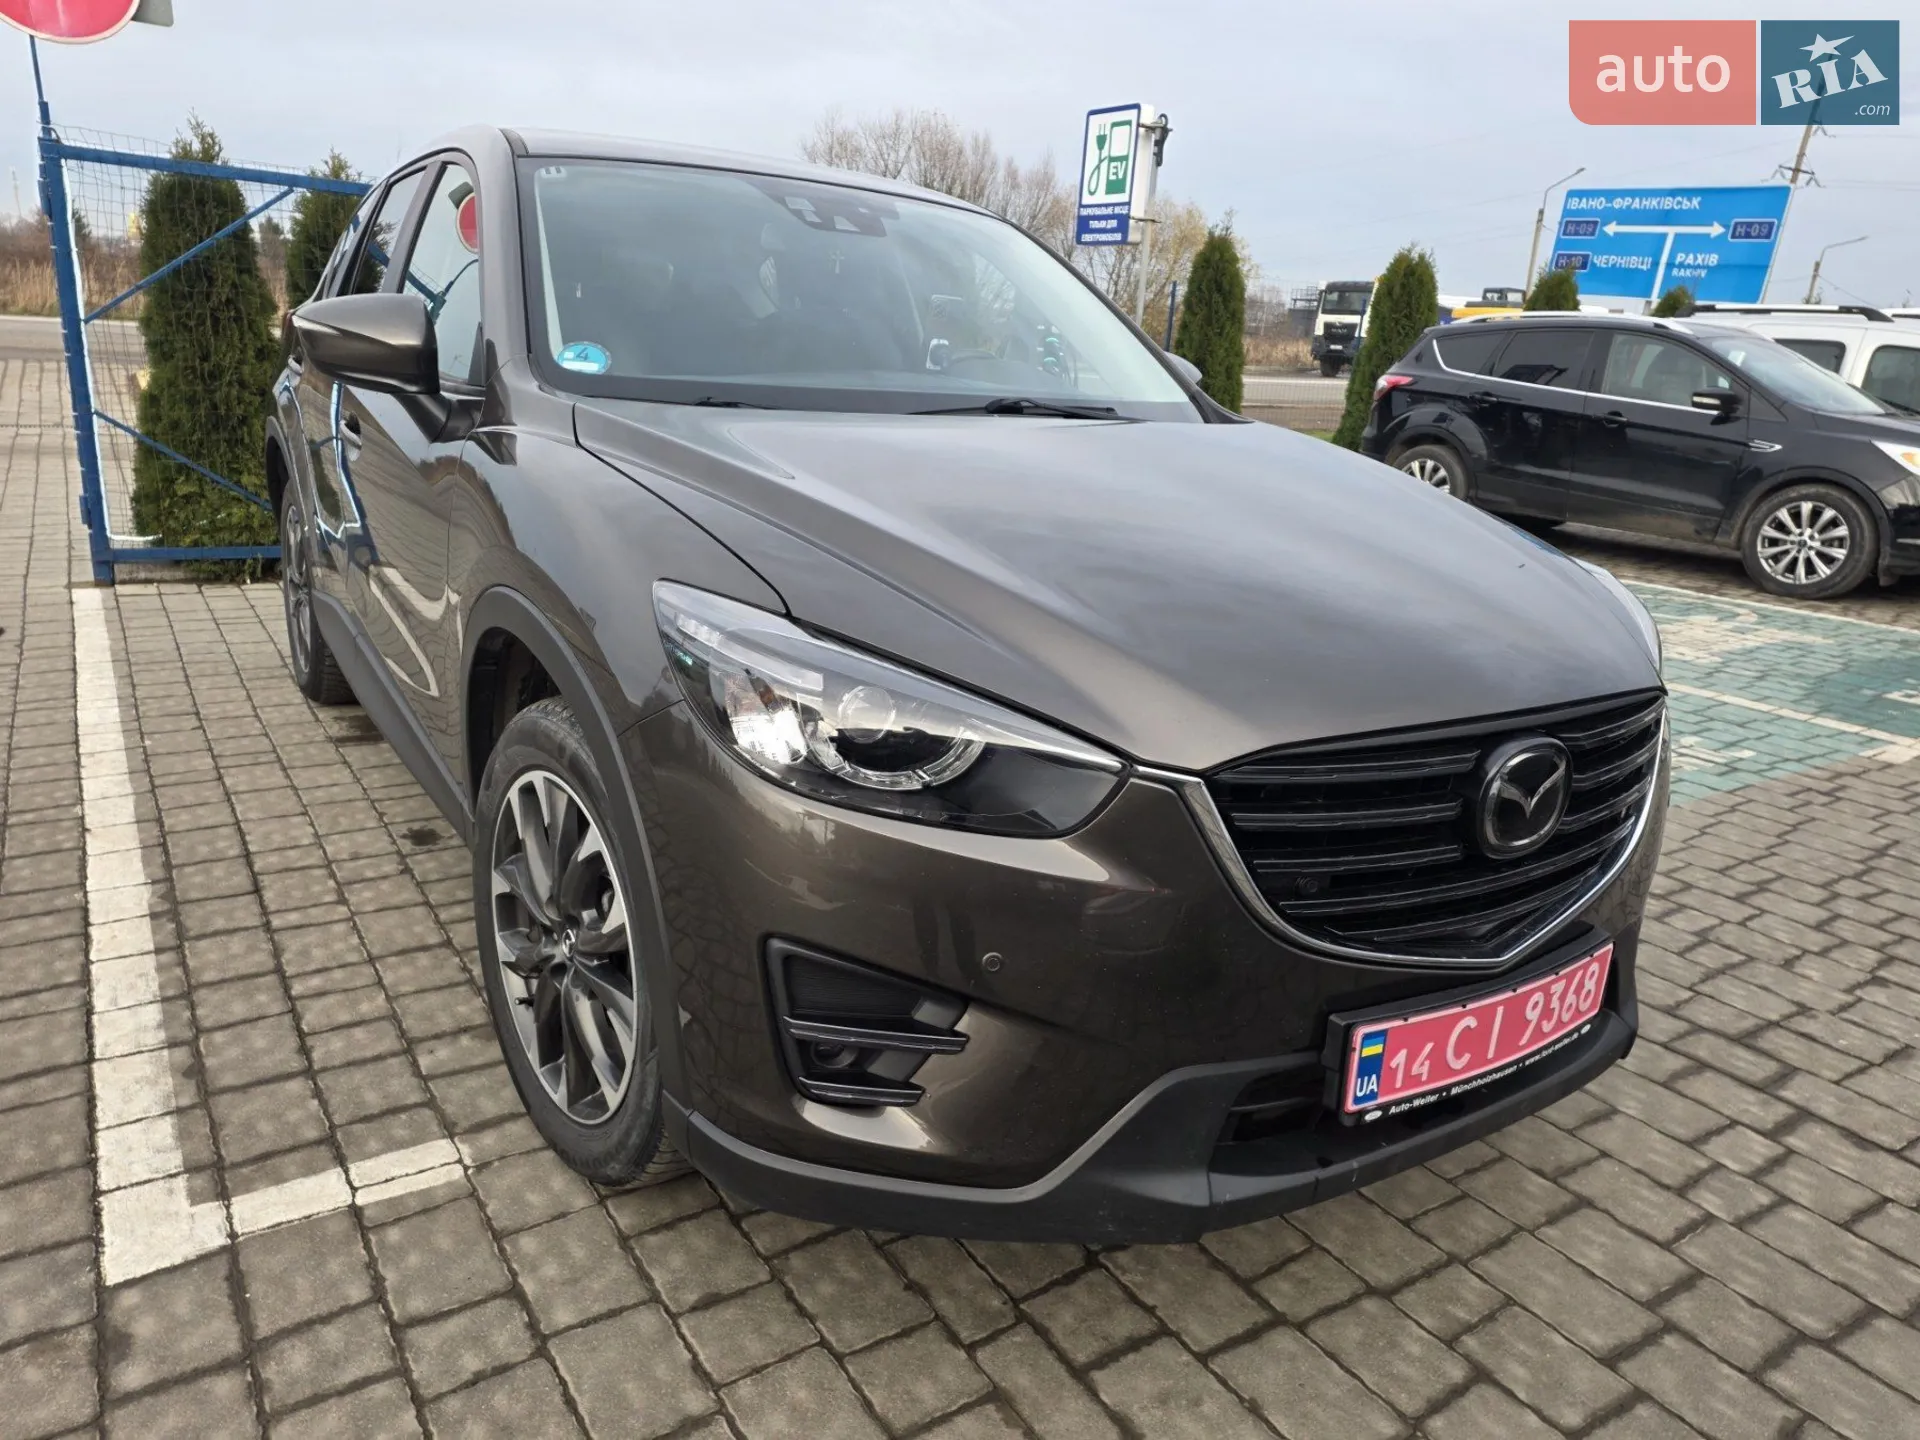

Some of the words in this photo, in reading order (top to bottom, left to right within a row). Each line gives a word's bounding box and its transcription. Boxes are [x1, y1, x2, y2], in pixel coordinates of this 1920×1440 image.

[1109, 161, 1126, 179] EV
[1566, 196, 1702, 210] ІВАНО-ФРАНКІВСЬК
[1593, 254, 1653, 271] ЧЕРНІВЦІ
[1675, 252, 1719, 267] РАХІВ
[575, 346, 589, 361] 4
[1389, 1041, 1435, 1089] 14
[1518, 962, 1601, 1047] 9368
[1355, 1073, 1378, 1098] UA
